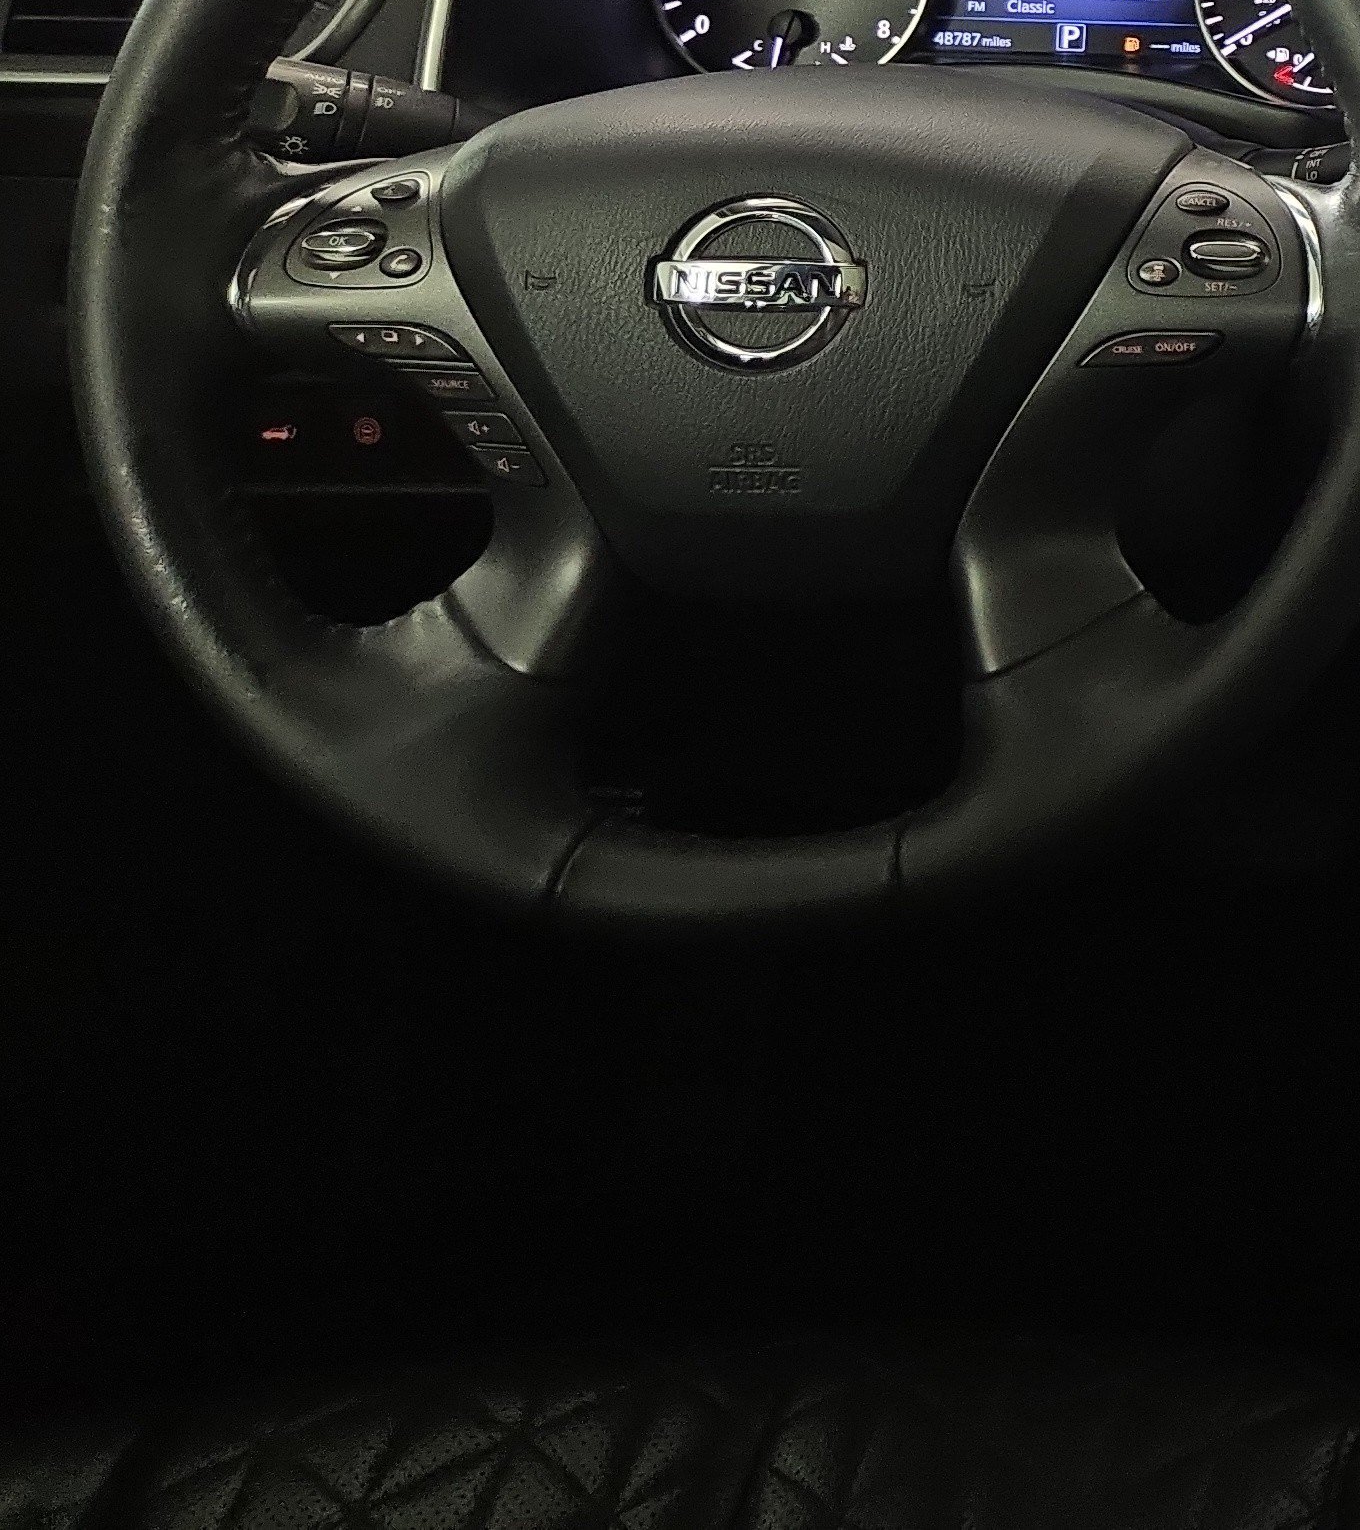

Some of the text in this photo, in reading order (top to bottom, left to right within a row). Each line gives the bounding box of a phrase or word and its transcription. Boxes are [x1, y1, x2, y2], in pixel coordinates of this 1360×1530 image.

[967, 1, 986, 12] FM
[1007, 0, 1056, 14] Classic
[694, 15, 710, 34] 0
[876, 20, 890, 38] 8
[933, 32, 1012, 48] 48787 miles
[1062, 26, 1080, 49] P
[753, 39, 763, 51] C
[820, 41, 830, 53] H
[1306, 159, 1322, 168] INT
[1306, 170, 1318, 181] LO
[1181, 197, 1217, 207] CANCEL
[329, 236, 349, 246] OK
[672, 269, 842, 302] NISSAN
[1112, 345, 1143, 354] CRUISE
[1155, 342, 1197, 353] ON/OFF
[430, 378, 470, 390] SOURCE
[731, 443, 778, 465] SRS
[709, 471, 802, 493] AIRBAG
